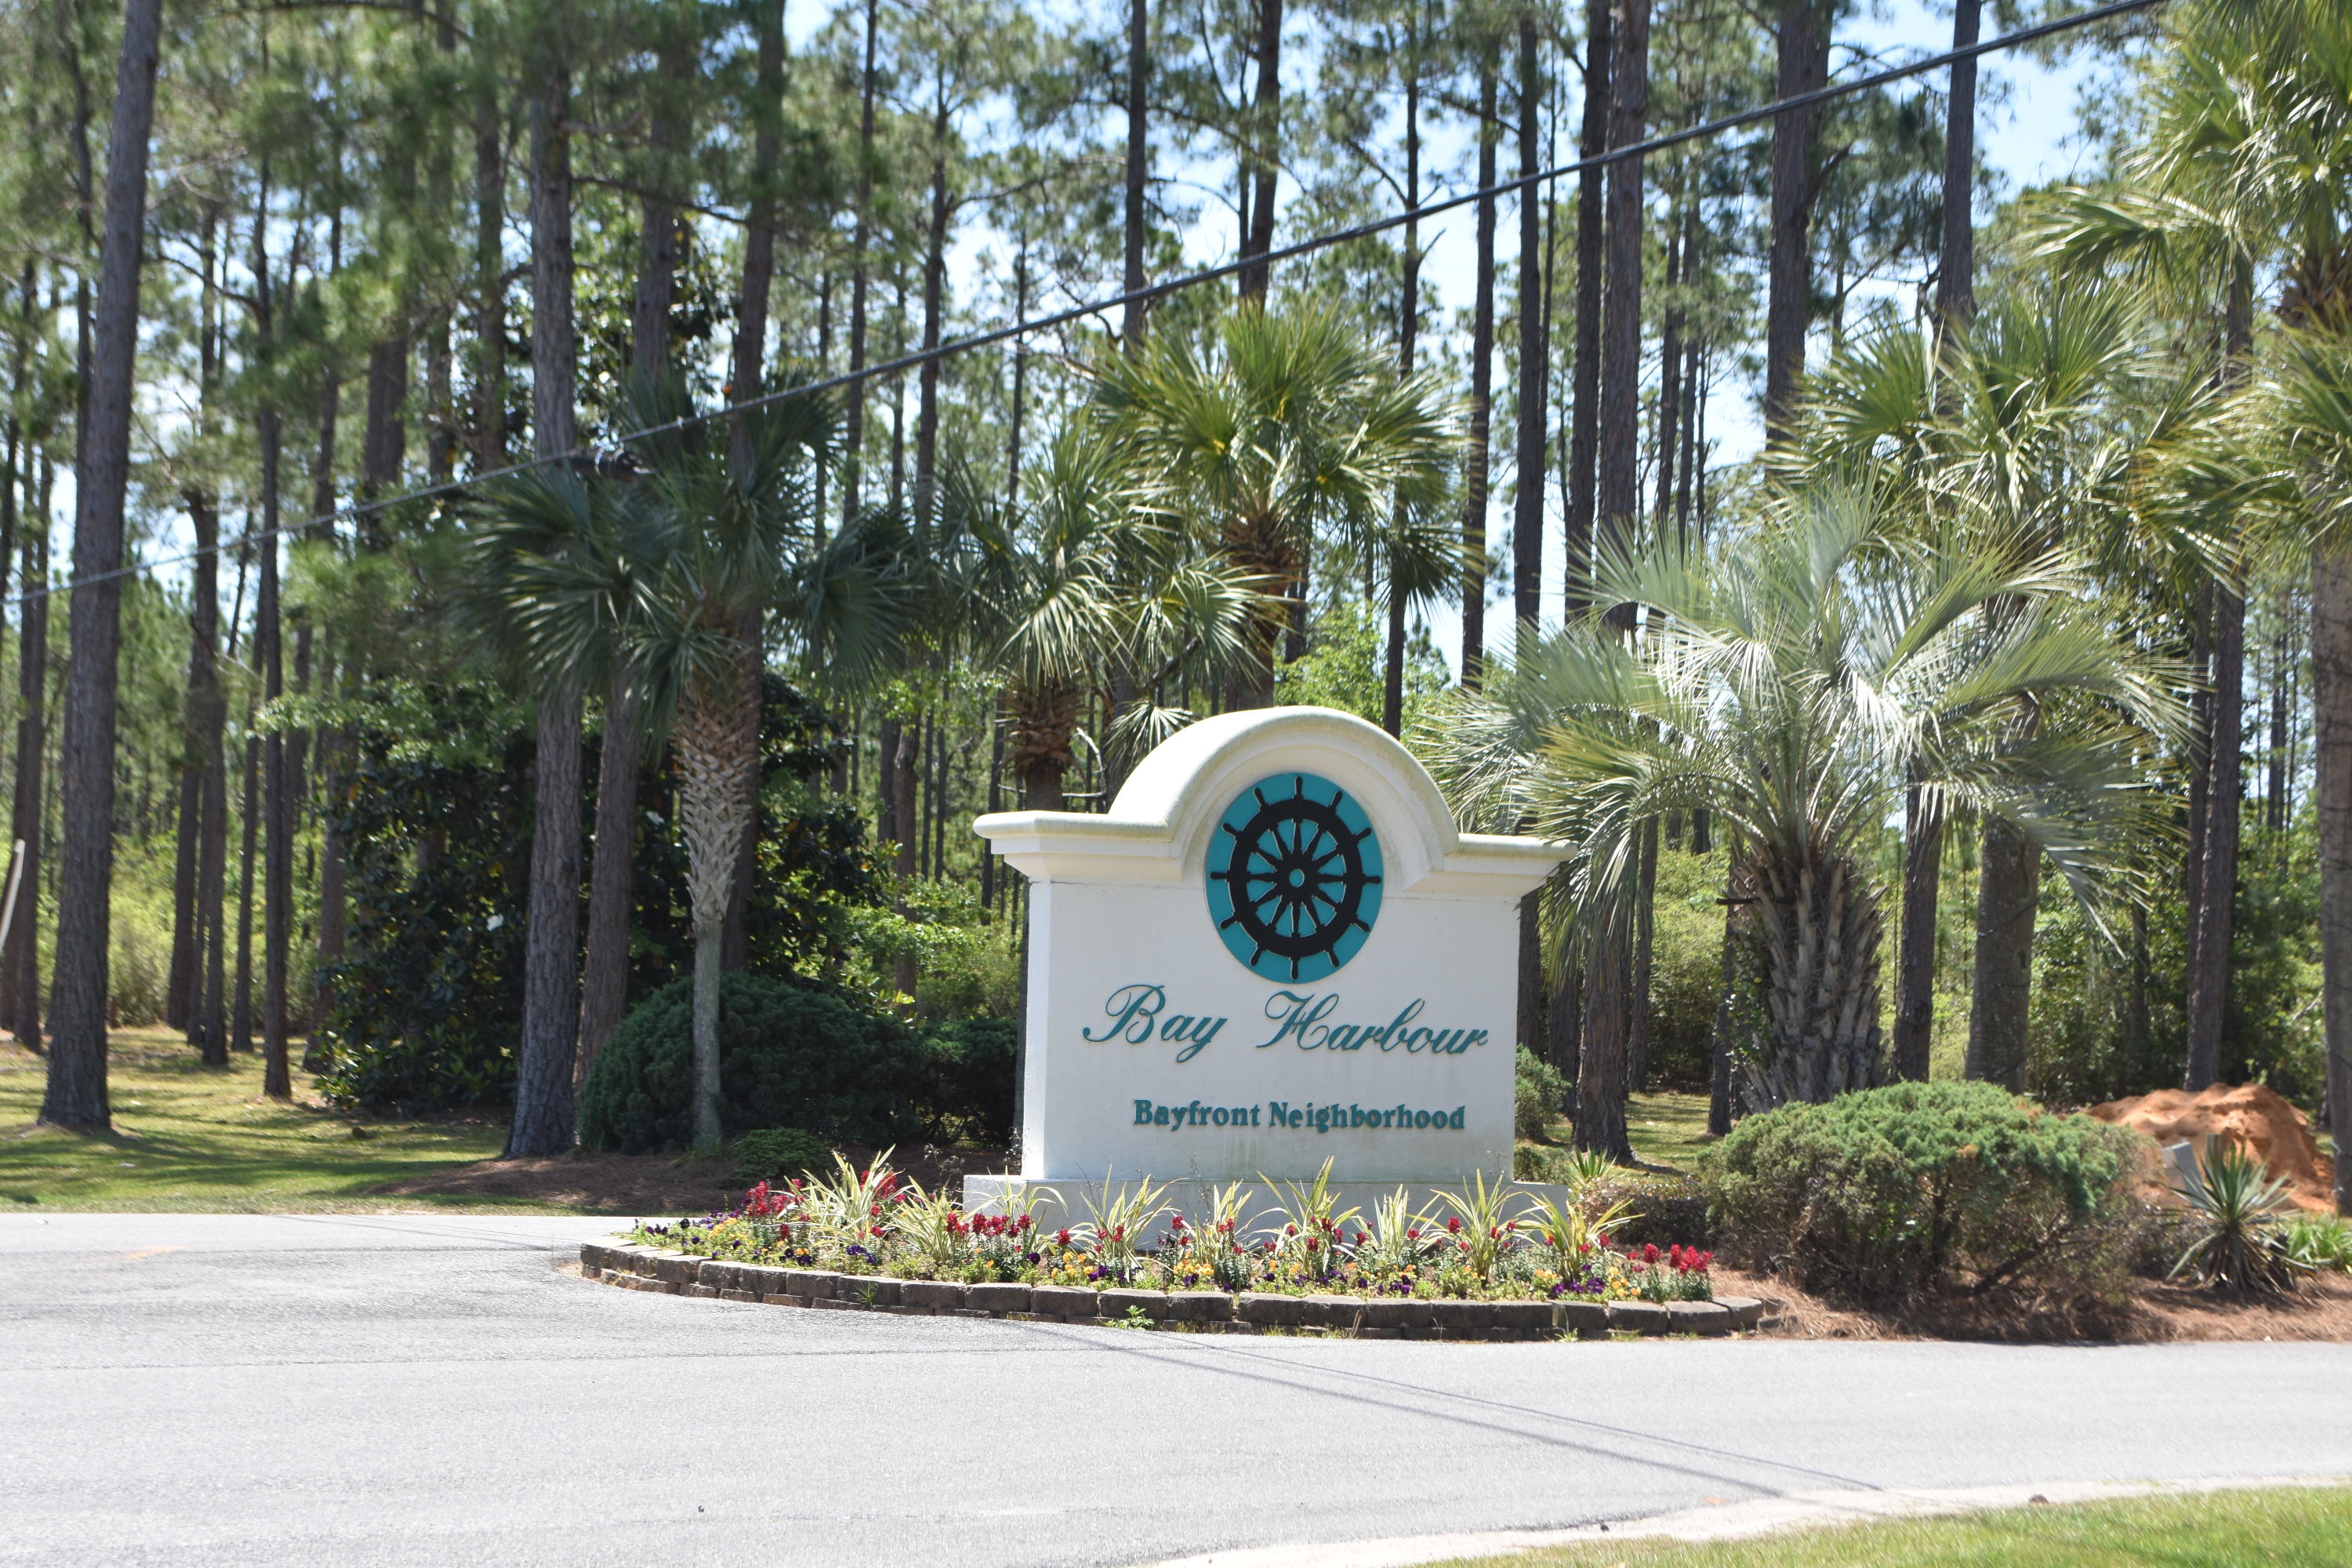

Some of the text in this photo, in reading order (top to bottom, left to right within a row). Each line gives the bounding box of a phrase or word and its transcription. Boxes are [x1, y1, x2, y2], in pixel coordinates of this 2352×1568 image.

[1081, 983, 1489, 1063] Bay Harbour
[1134, 1098, 1466, 1134] Bayfront Neighborhood
